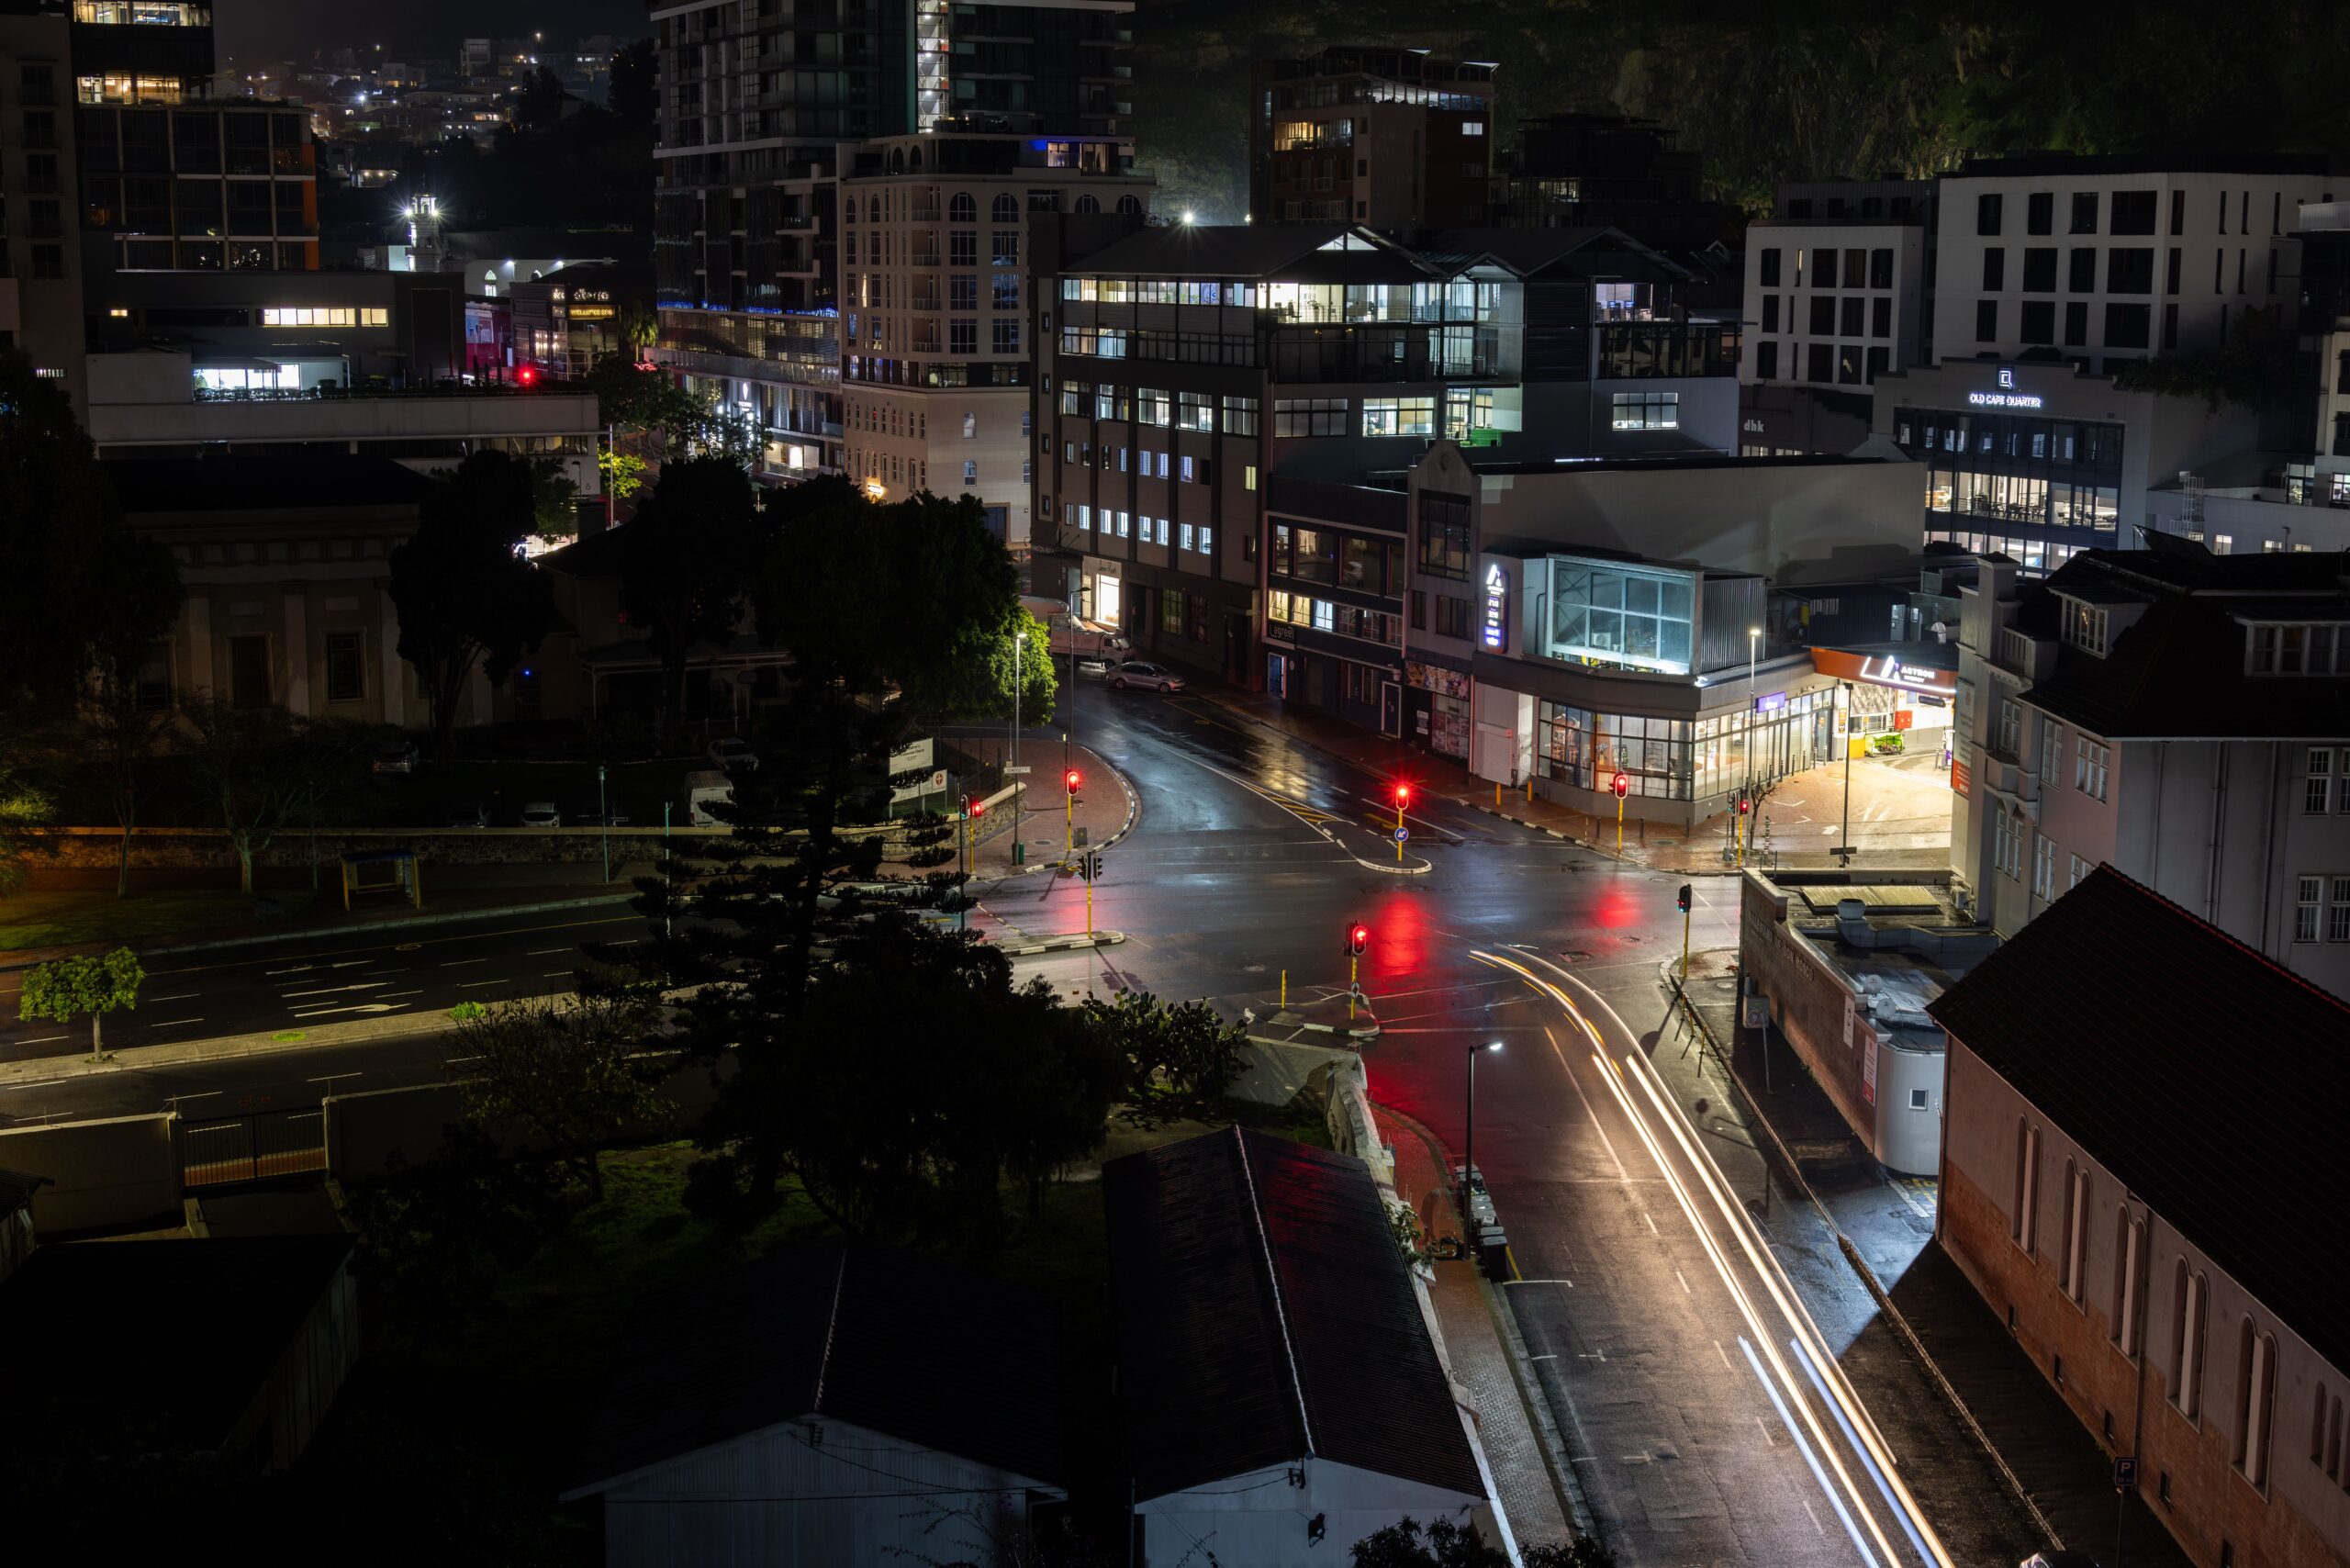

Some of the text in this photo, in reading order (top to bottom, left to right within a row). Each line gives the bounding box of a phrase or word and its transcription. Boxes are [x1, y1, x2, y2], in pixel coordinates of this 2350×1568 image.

[1969, 393, 2041, 408] OLD CAPE QUARTER
[1743, 419, 1764, 432] dhk
[1901, 666, 1935, 679] ASTRON
[2121, 1462, 2131, 1473] P
